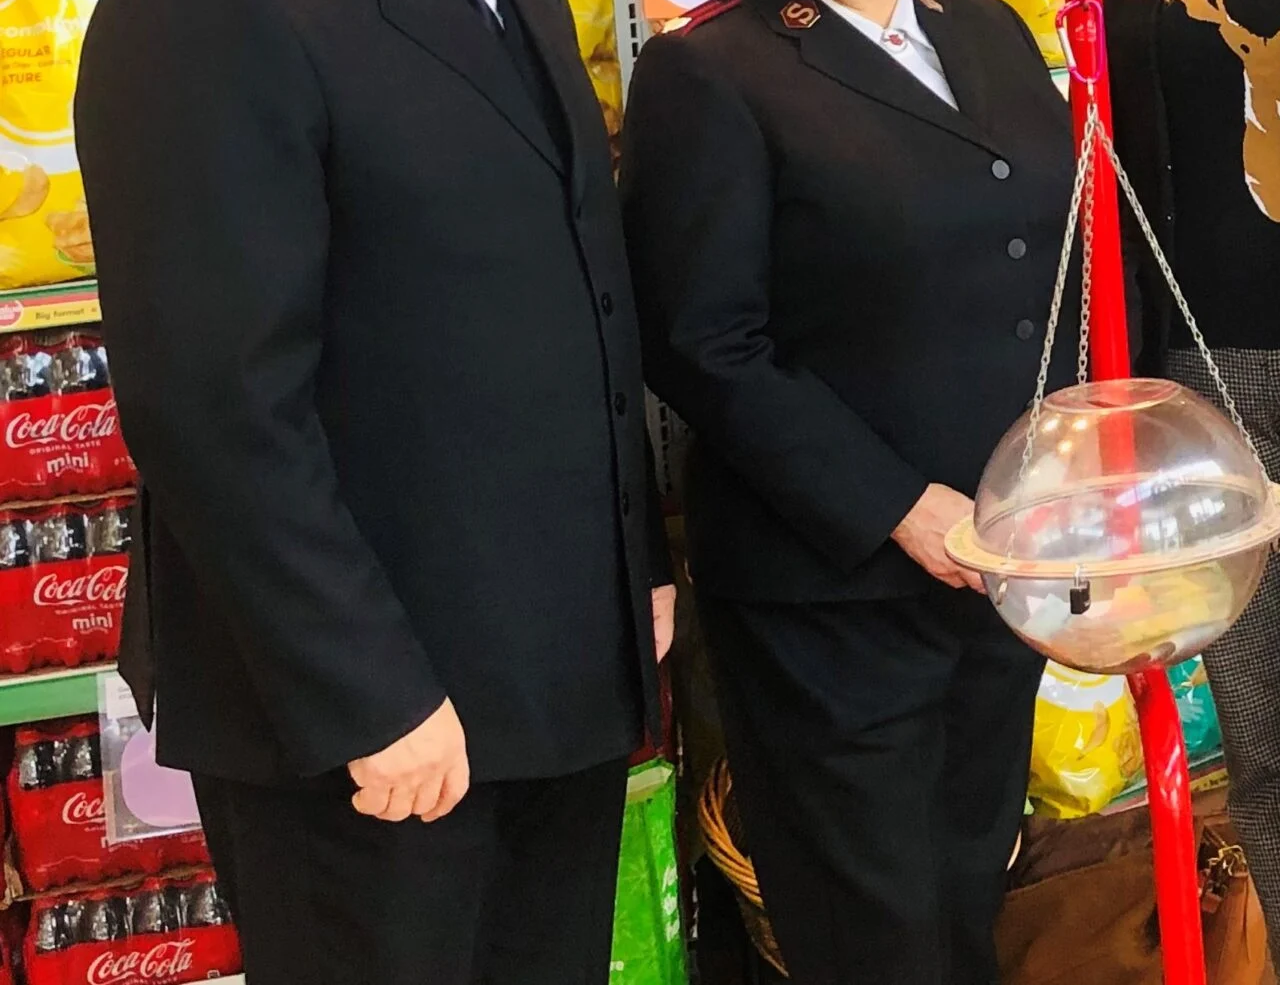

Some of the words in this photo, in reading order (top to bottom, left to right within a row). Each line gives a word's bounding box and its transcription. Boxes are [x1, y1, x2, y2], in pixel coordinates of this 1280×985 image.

[0, 45, 51, 57] EGULAR
[2, 72, 42, 86] ATURE
[6, 401, 118, 449] Coca-Cola
[29, 444, 73, 455] ORIGINAL
[46, 452, 89, 473] mini
[72, 612, 113, 630] mini
